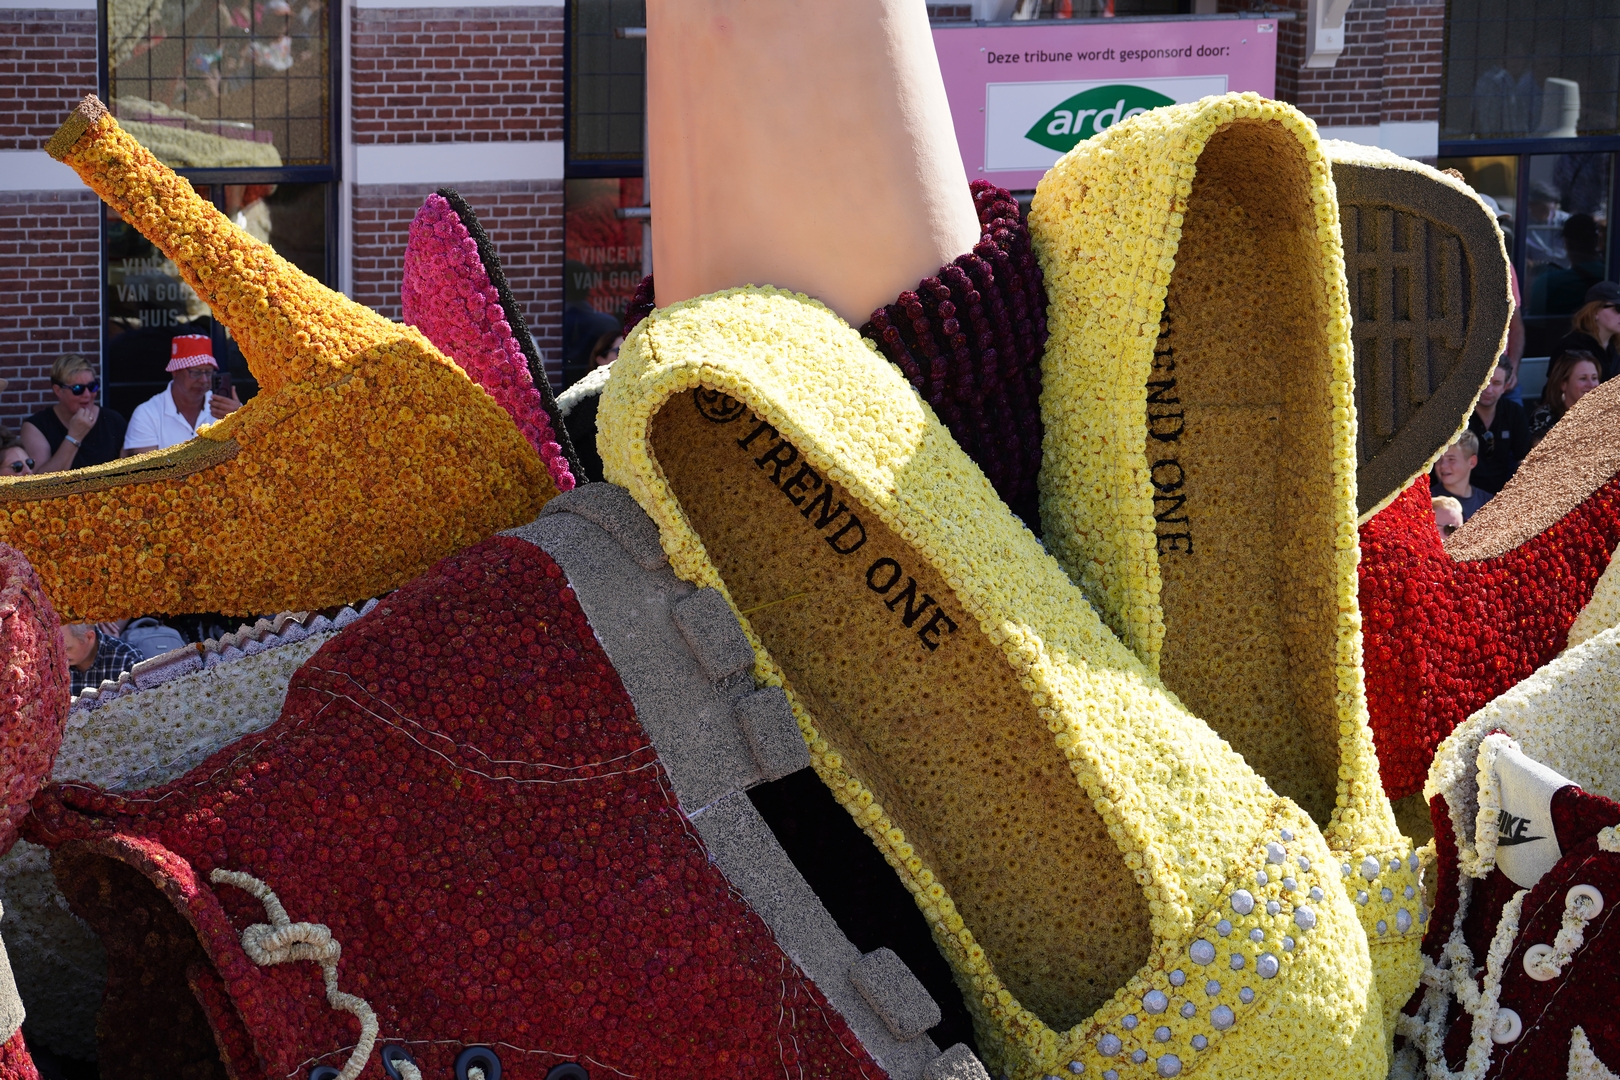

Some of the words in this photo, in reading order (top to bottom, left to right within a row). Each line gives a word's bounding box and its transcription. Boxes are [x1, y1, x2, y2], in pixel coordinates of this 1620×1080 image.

[987, 51, 1020, 64] Deze
[1024, 49, 1073, 63] tribune
[1077, 48, 1115, 61] wordt
[1119, 45, 1192, 62] gesponsord
[1196, 45, 1230, 58] door:
[573, 272, 603, 290] VAN
[609, 271, 643, 289] GOG
[116, 283, 149, 302] VAN
[138, 308, 179, 327] HUIS
[1150, 459, 1194, 556] ONE
[737, 413, 868, 555] TREND
[865, 557, 958, 651] ONE
